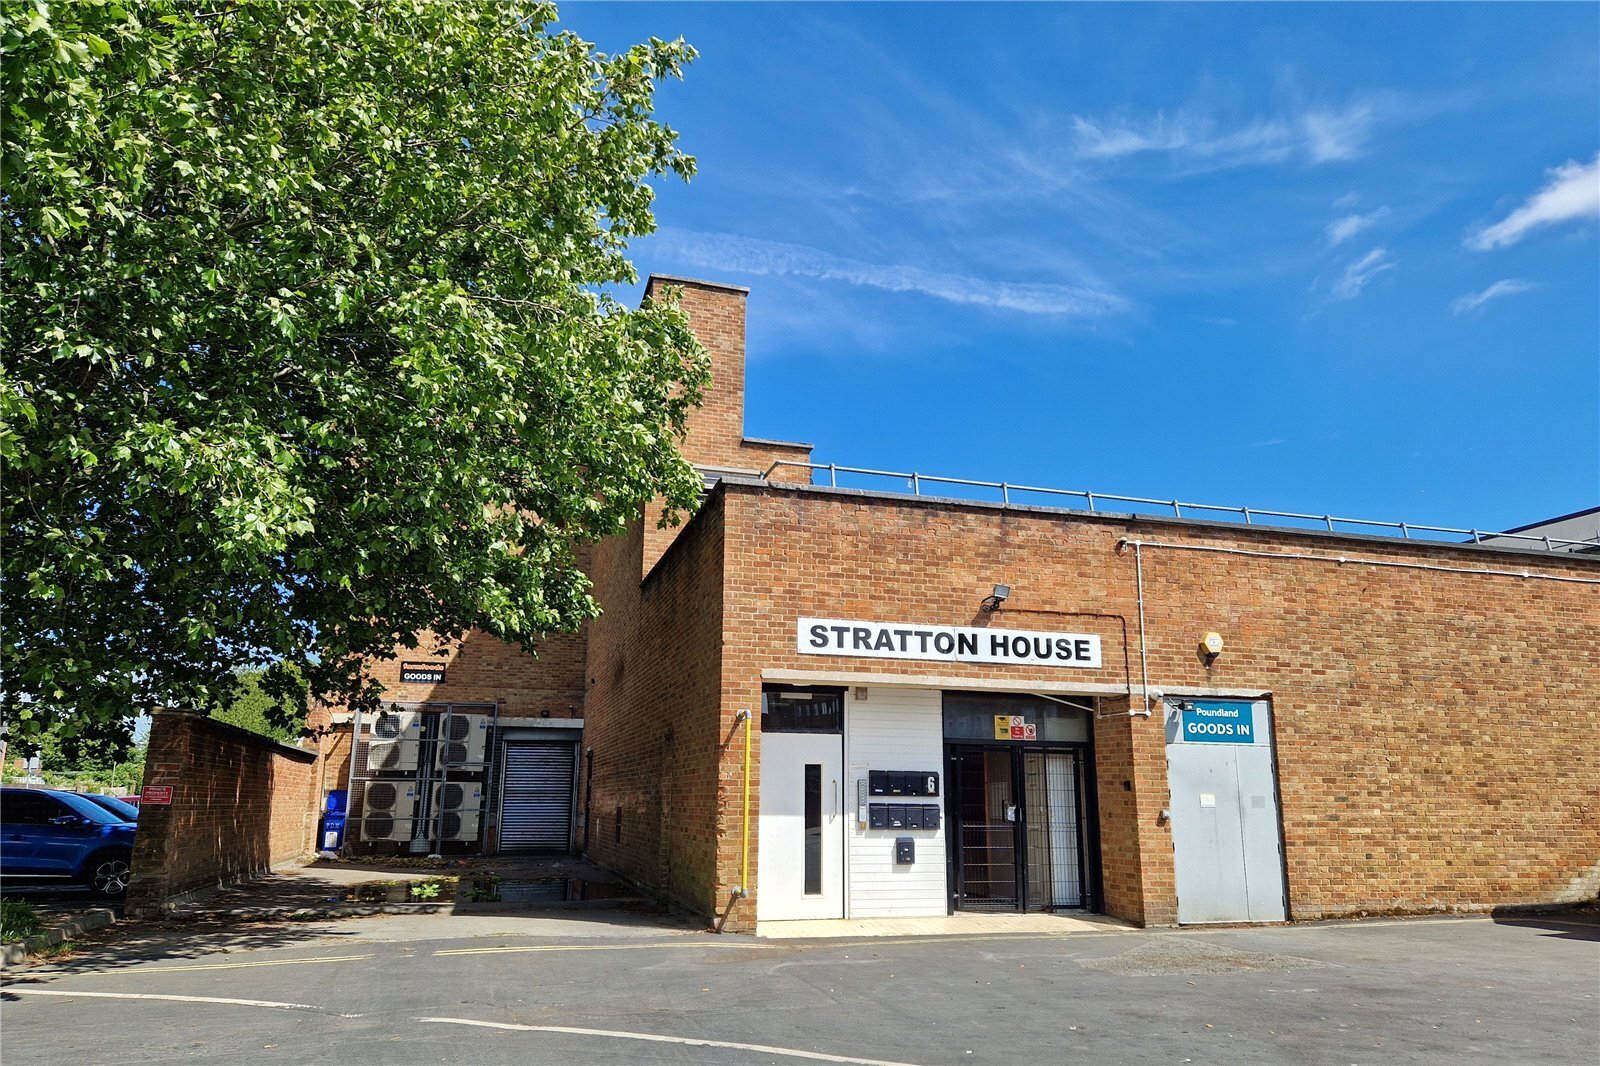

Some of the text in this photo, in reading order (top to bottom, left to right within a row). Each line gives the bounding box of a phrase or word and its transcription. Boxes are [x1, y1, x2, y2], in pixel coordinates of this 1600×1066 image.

[809, 624, 1092, 661] STRATTON HOUSE
[404, 672, 442, 681] GOODS IN
[1196, 707, 1239, 718] Poundland
[1187, 722, 1250, 736] GOODS IN
[927, 776, 936, 792] 6
